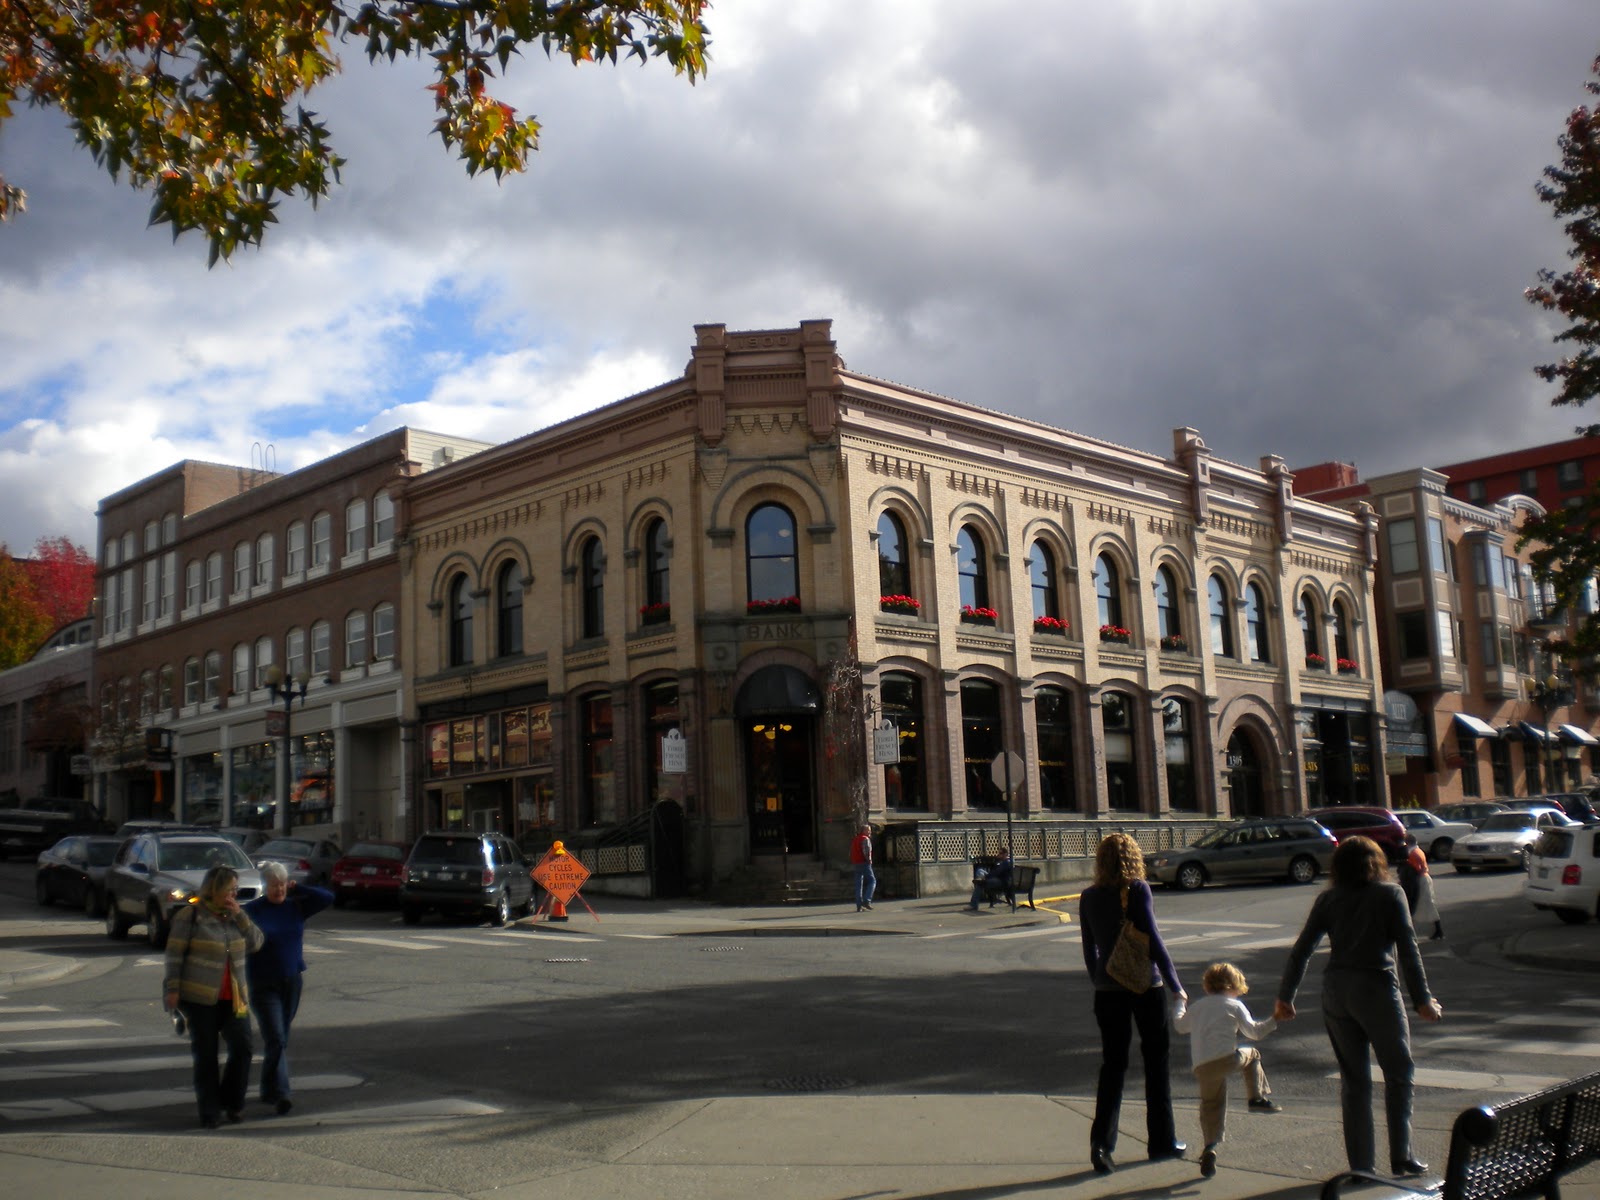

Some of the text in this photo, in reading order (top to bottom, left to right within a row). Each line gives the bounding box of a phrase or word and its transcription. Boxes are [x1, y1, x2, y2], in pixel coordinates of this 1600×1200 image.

[739, 336, 789, 348] 1900
[748, 623, 802, 640] BANK
[1304, 761, 1319, 772] LATS
[548, 864, 573, 872] CYCLES
[538, 873, 584, 881] USE EXTREME
[549, 882, 576, 890] CAUTION
